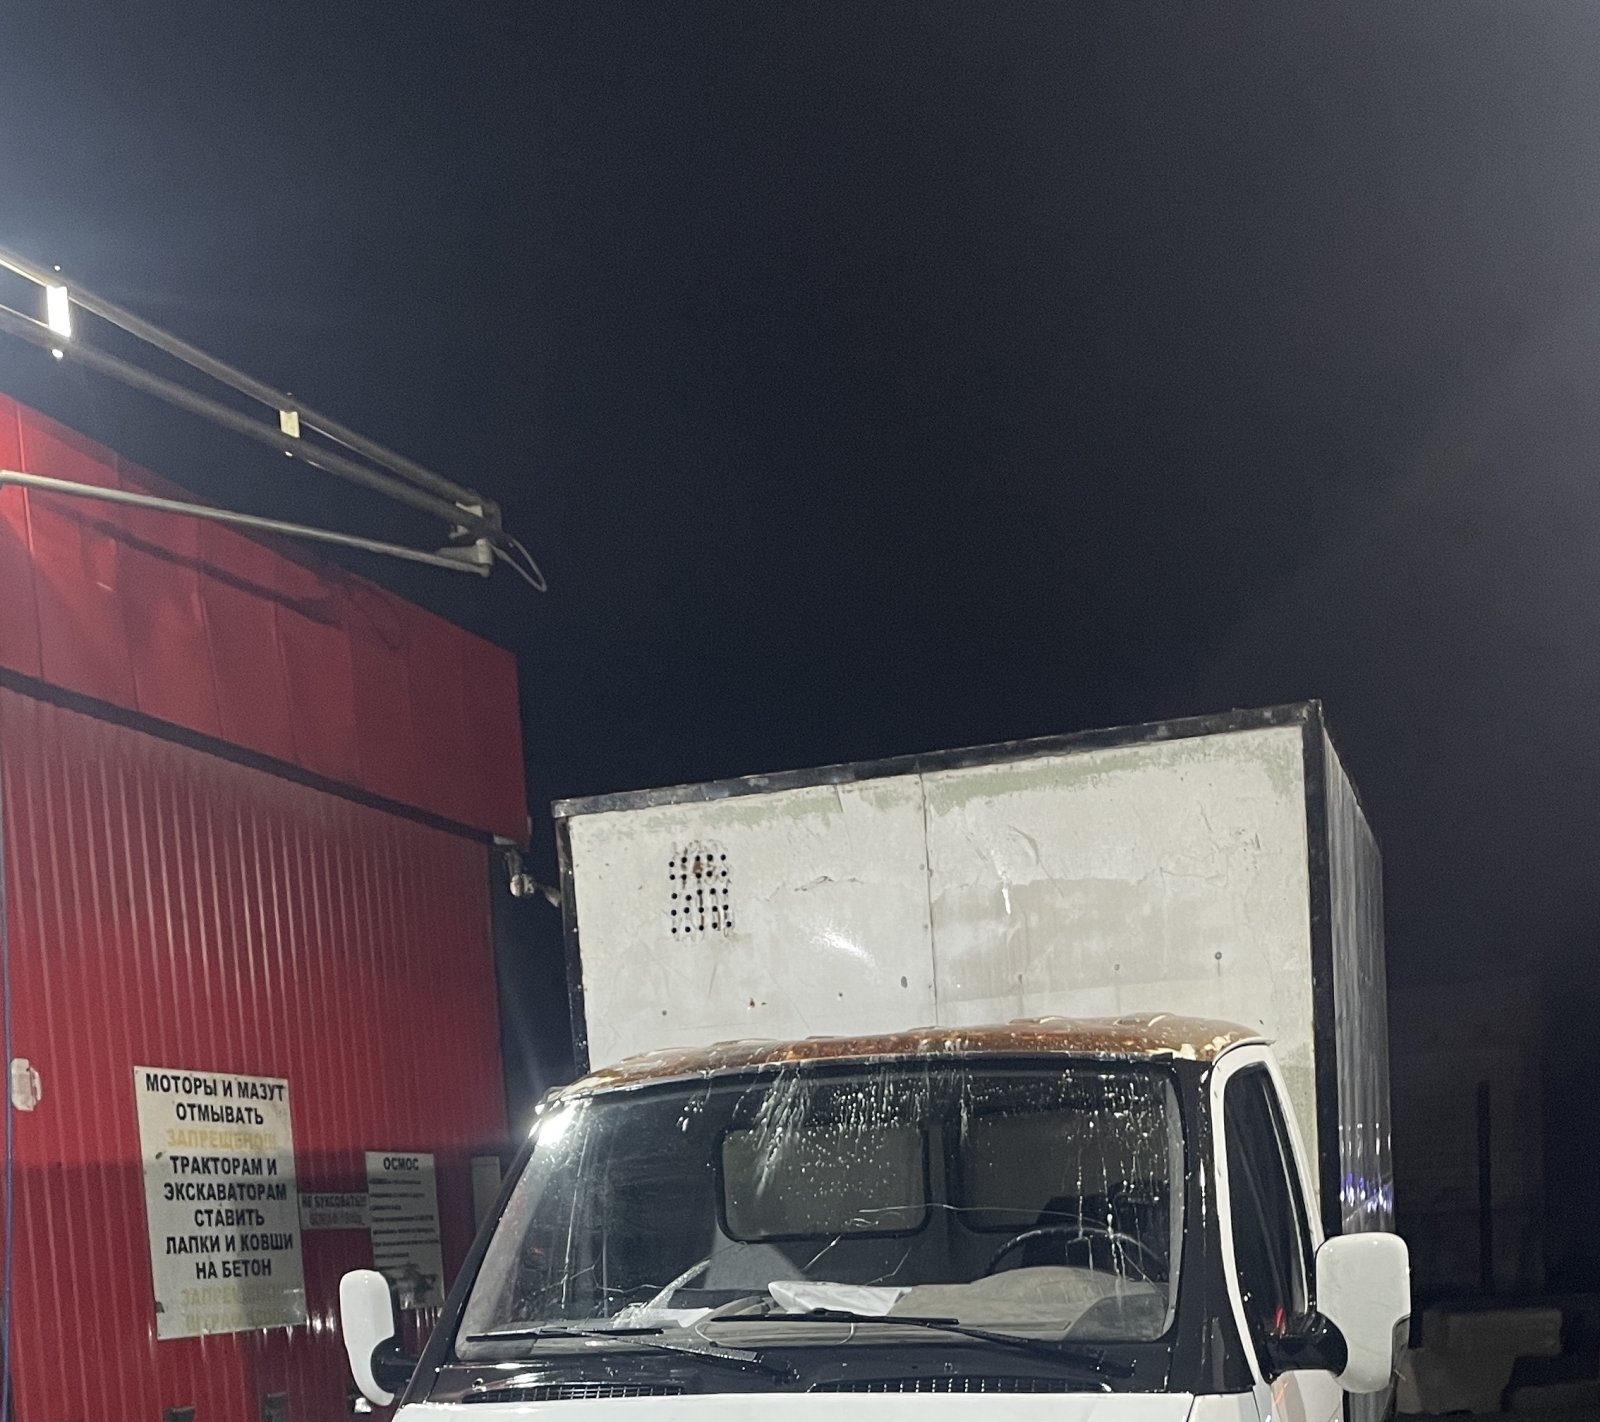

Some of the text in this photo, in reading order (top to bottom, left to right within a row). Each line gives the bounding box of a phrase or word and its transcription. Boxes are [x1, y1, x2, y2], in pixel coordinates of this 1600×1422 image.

[145, 1073, 287, 1101] МОТОРЫ И МАЗУТ
[176, 1102, 264, 1125] ОТМЫВАТЬ
[170, 1156, 277, 1175] ТРАКТОРАМ И
[164, 1183, 287, 1201] ЭКСКАВАТОРАМ
[194, 1208, 265, 1227] СТАВИТЬ
[166, 1233, 293, 1254] ЛАПКИ И КОВШИ
[195, 1259, 271, 1279] НА БЕТОН
